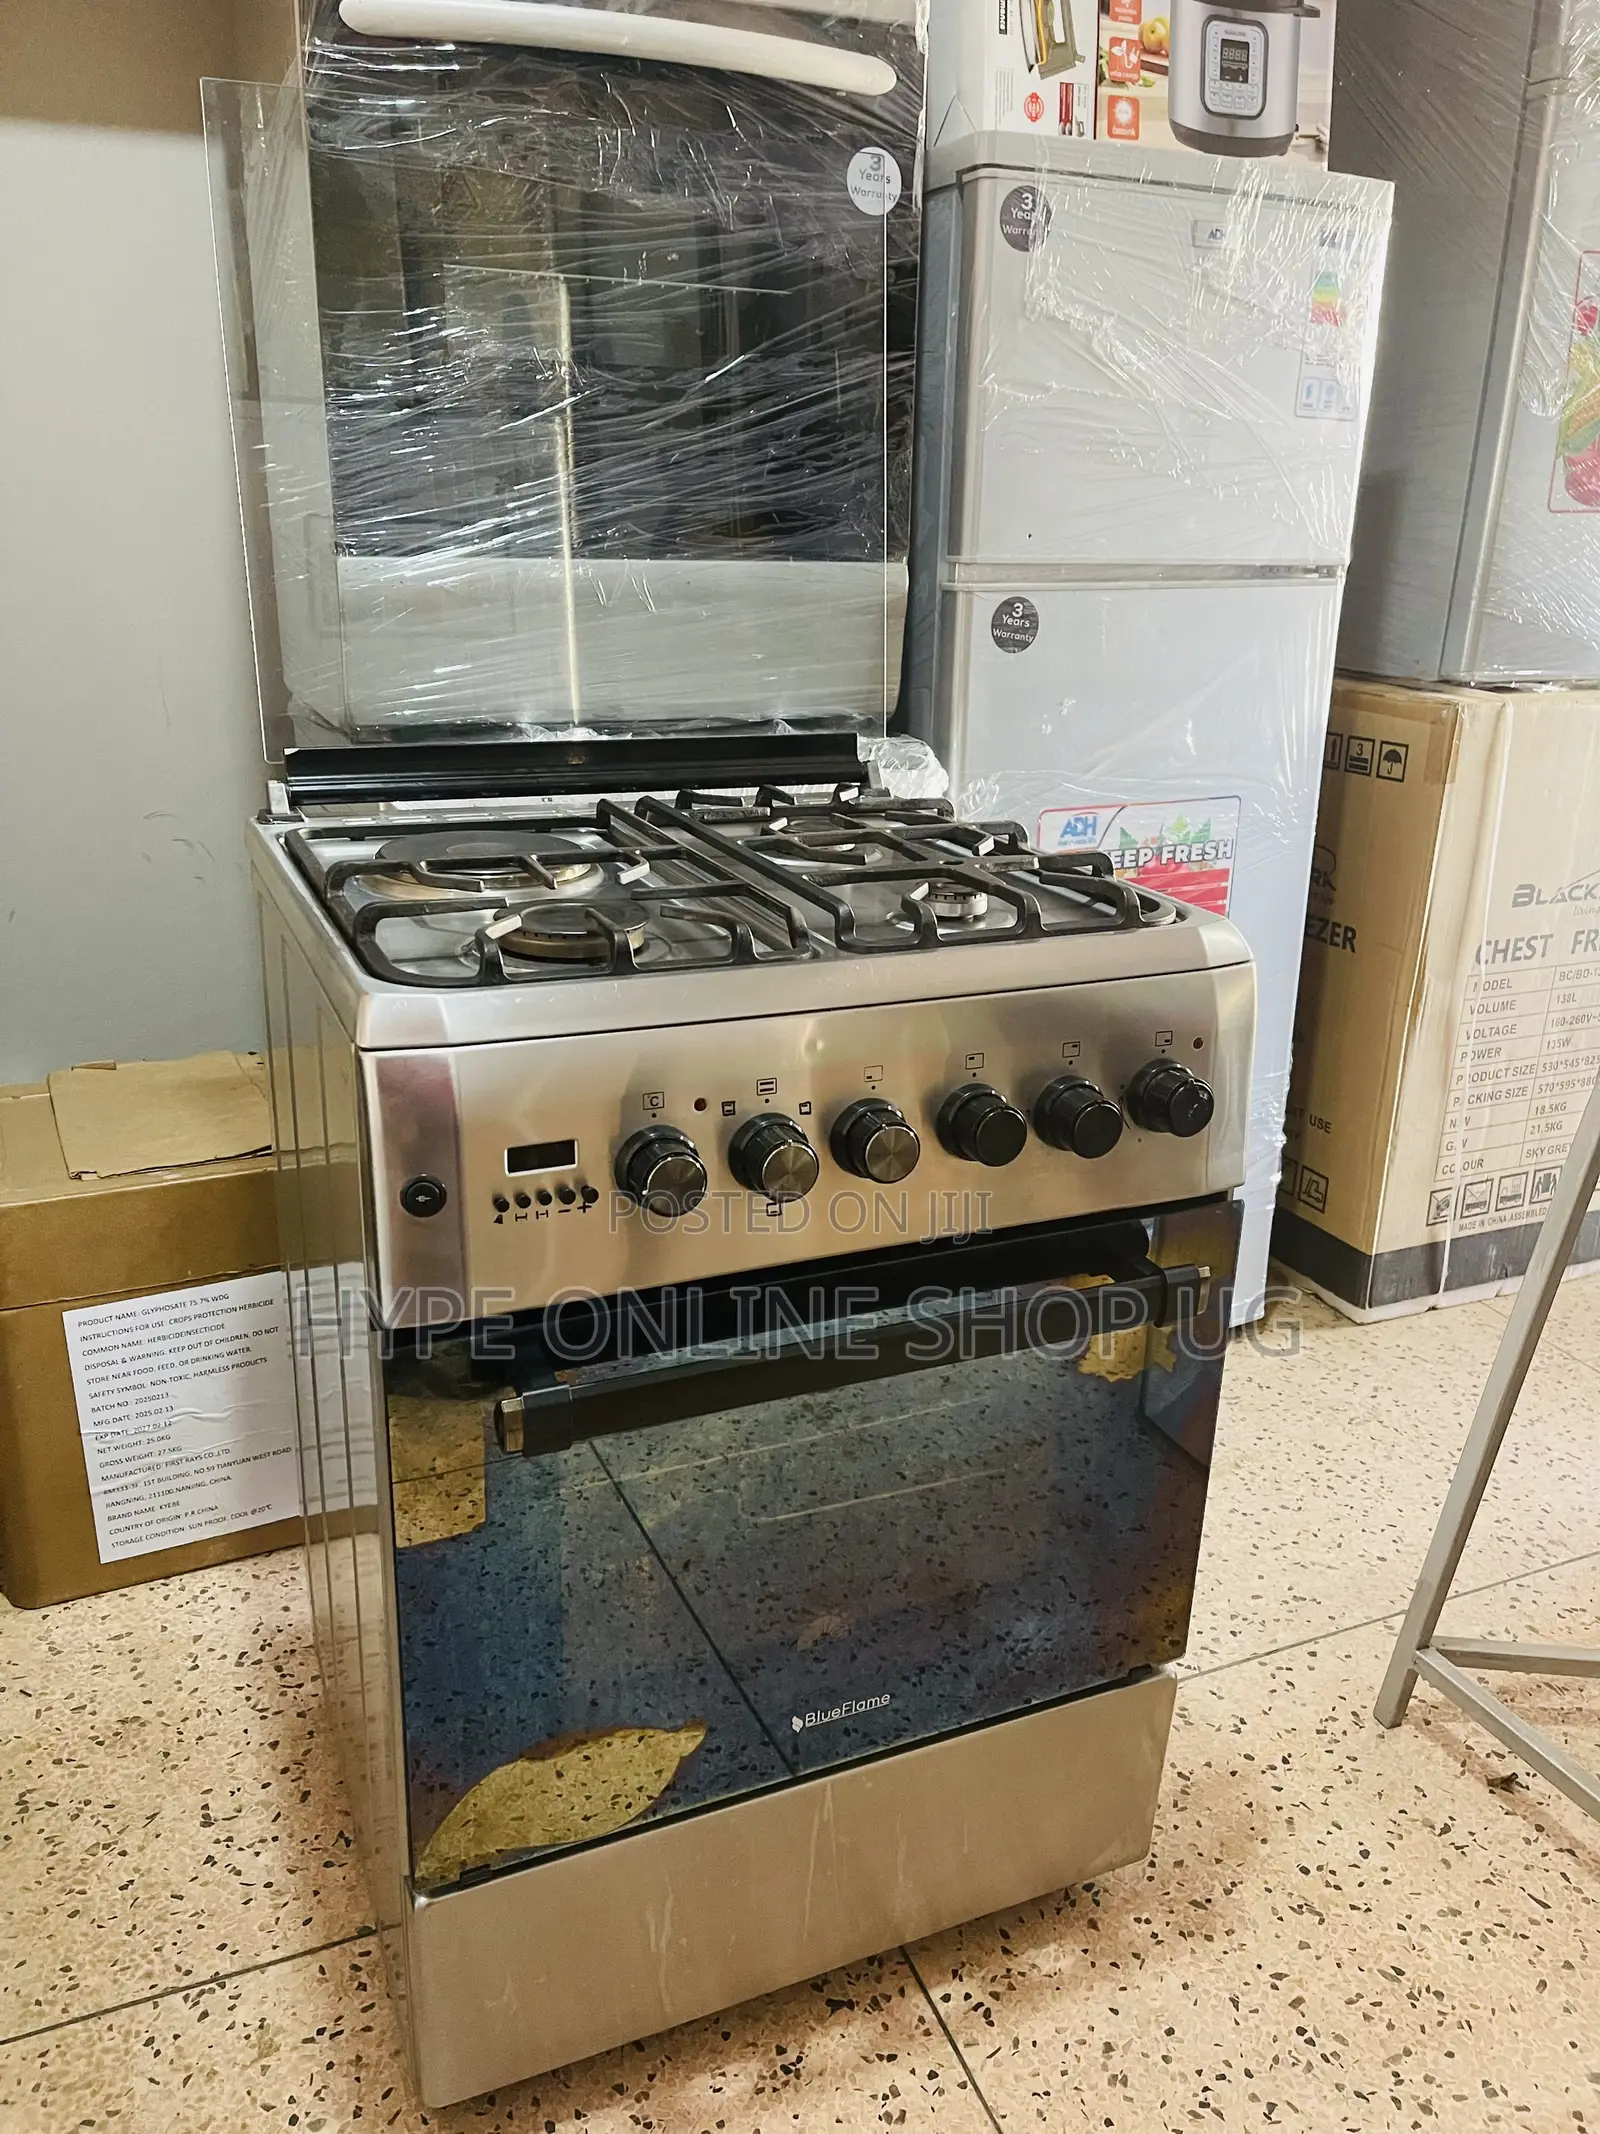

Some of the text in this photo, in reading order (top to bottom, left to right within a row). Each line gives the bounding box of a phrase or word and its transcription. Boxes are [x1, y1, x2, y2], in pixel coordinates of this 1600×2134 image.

[870, 155, 882, 171] 3
[859, 168, 891, 184] Years
[850, 185, 898, 202] Warraty
[1021, 193, 1033, 210] 3
[1012, 603, 1024, 617] 3
[1002, 614, 1030, 627] Years
[992, 628, 1035, 643] Warranty
[1356, 743, 1364, 756] 3
[1060, 815, 1098, 838] ADH
[1109, 838, 1235, 869] EEP FRESH
[1475, 934, 1554, 965] CHEST
[1470, 1000, 1517, 1015] VOLUME
[1466, 1024, 1517, 1040] VOLTAGE
[1460, 1037, 1571, 1063] POWER 135W
[1512, 1064, 1536, 1077] SIZE
[1453, 1090, 1503, 1107] PCKING
[1505, 1086, 1529, 1099] SIZE
[1309, 1115, 1332, 1134] USE
[1530, 1120, 1563, 1135] 21.5KG
[1442, 1159, 1484, 1175] COOUR
[1525, 1146, 1546, 1159] SKY
[1459, 1220, 1476, 1232] MADE
[1479, 1219, 1485, 1227] IN
[78, 1315, 113, 1327] PRODUCT
[141, 1301, 187, 1316] GLYPHOSATE
[80, 1326, 134, 1342] INSTRUCTIONS
[168, 1315, 192, 1325] CROPS
[193, 1306, 238, 1320] PROTECTION
[238, 1298, 274, 1311] HERBICIDE
[82, 1344, 120, 1357] COMMON
[84, 1359, 119, 1371] DISPOSAL
[168, 1346, 186, 1354] KEEP
[187, 1342, 202, 1351] OUT
[264, 1326, 279, 1334] NOT
[86, 1375, 110, 1385] STORE
[111, 1371, 132, 1380] NEAR
[190, 1352, 225, 1364] DRINKING
[89, 1389, 115, 1399] SAFETY
[193, 1365, 230, 1378] HARMLESS
[231, 1357, 268, 1370] PRODUCTS
[91, 1404, 116, 1413] BATCH
[93, 1418, 111, 1427] MFG
[143, 1479, 156, 1487] 1ST
[252, 1451, 271, 1461] WEST
[164, 1457, 184, 1468] FIRST
[184, 1455, 203, 1463] RAYS
[107, 1511, 133, 1522] BRAND
[109, 1523, 143, 1535] COUNTRY
[111, 1536, 144, 1548] STORAGE
[188, 1522, 203, 1530] SUN
[230, 1511, 249, 1520] COOL
[805, 1694, 891, 1727] BlueFlame
